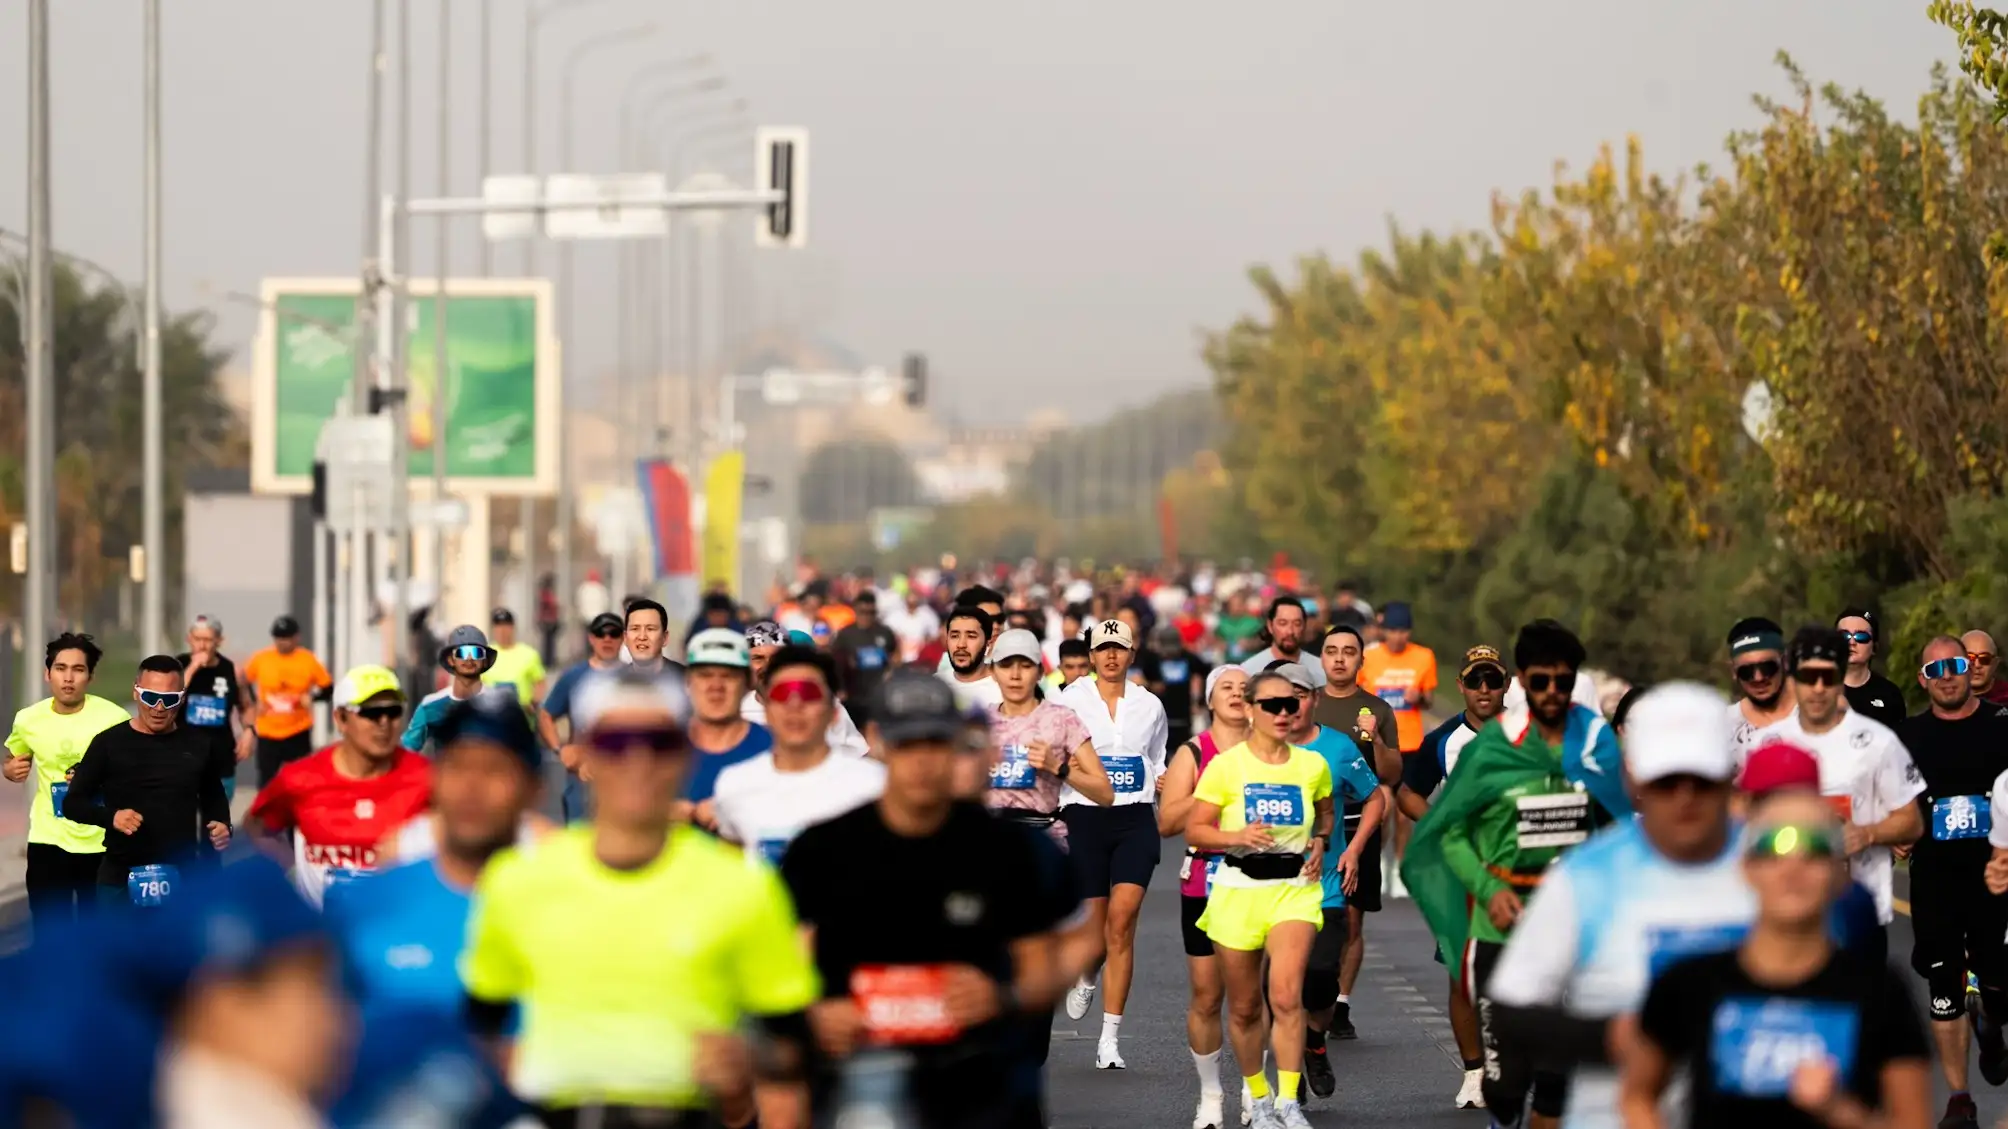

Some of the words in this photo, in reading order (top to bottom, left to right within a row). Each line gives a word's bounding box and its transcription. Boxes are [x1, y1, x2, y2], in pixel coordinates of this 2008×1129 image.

[1256, 799, 1293, 816] 896
[1945, 813, 1977, 831] 961
[139, 881, 171, 898] 780
